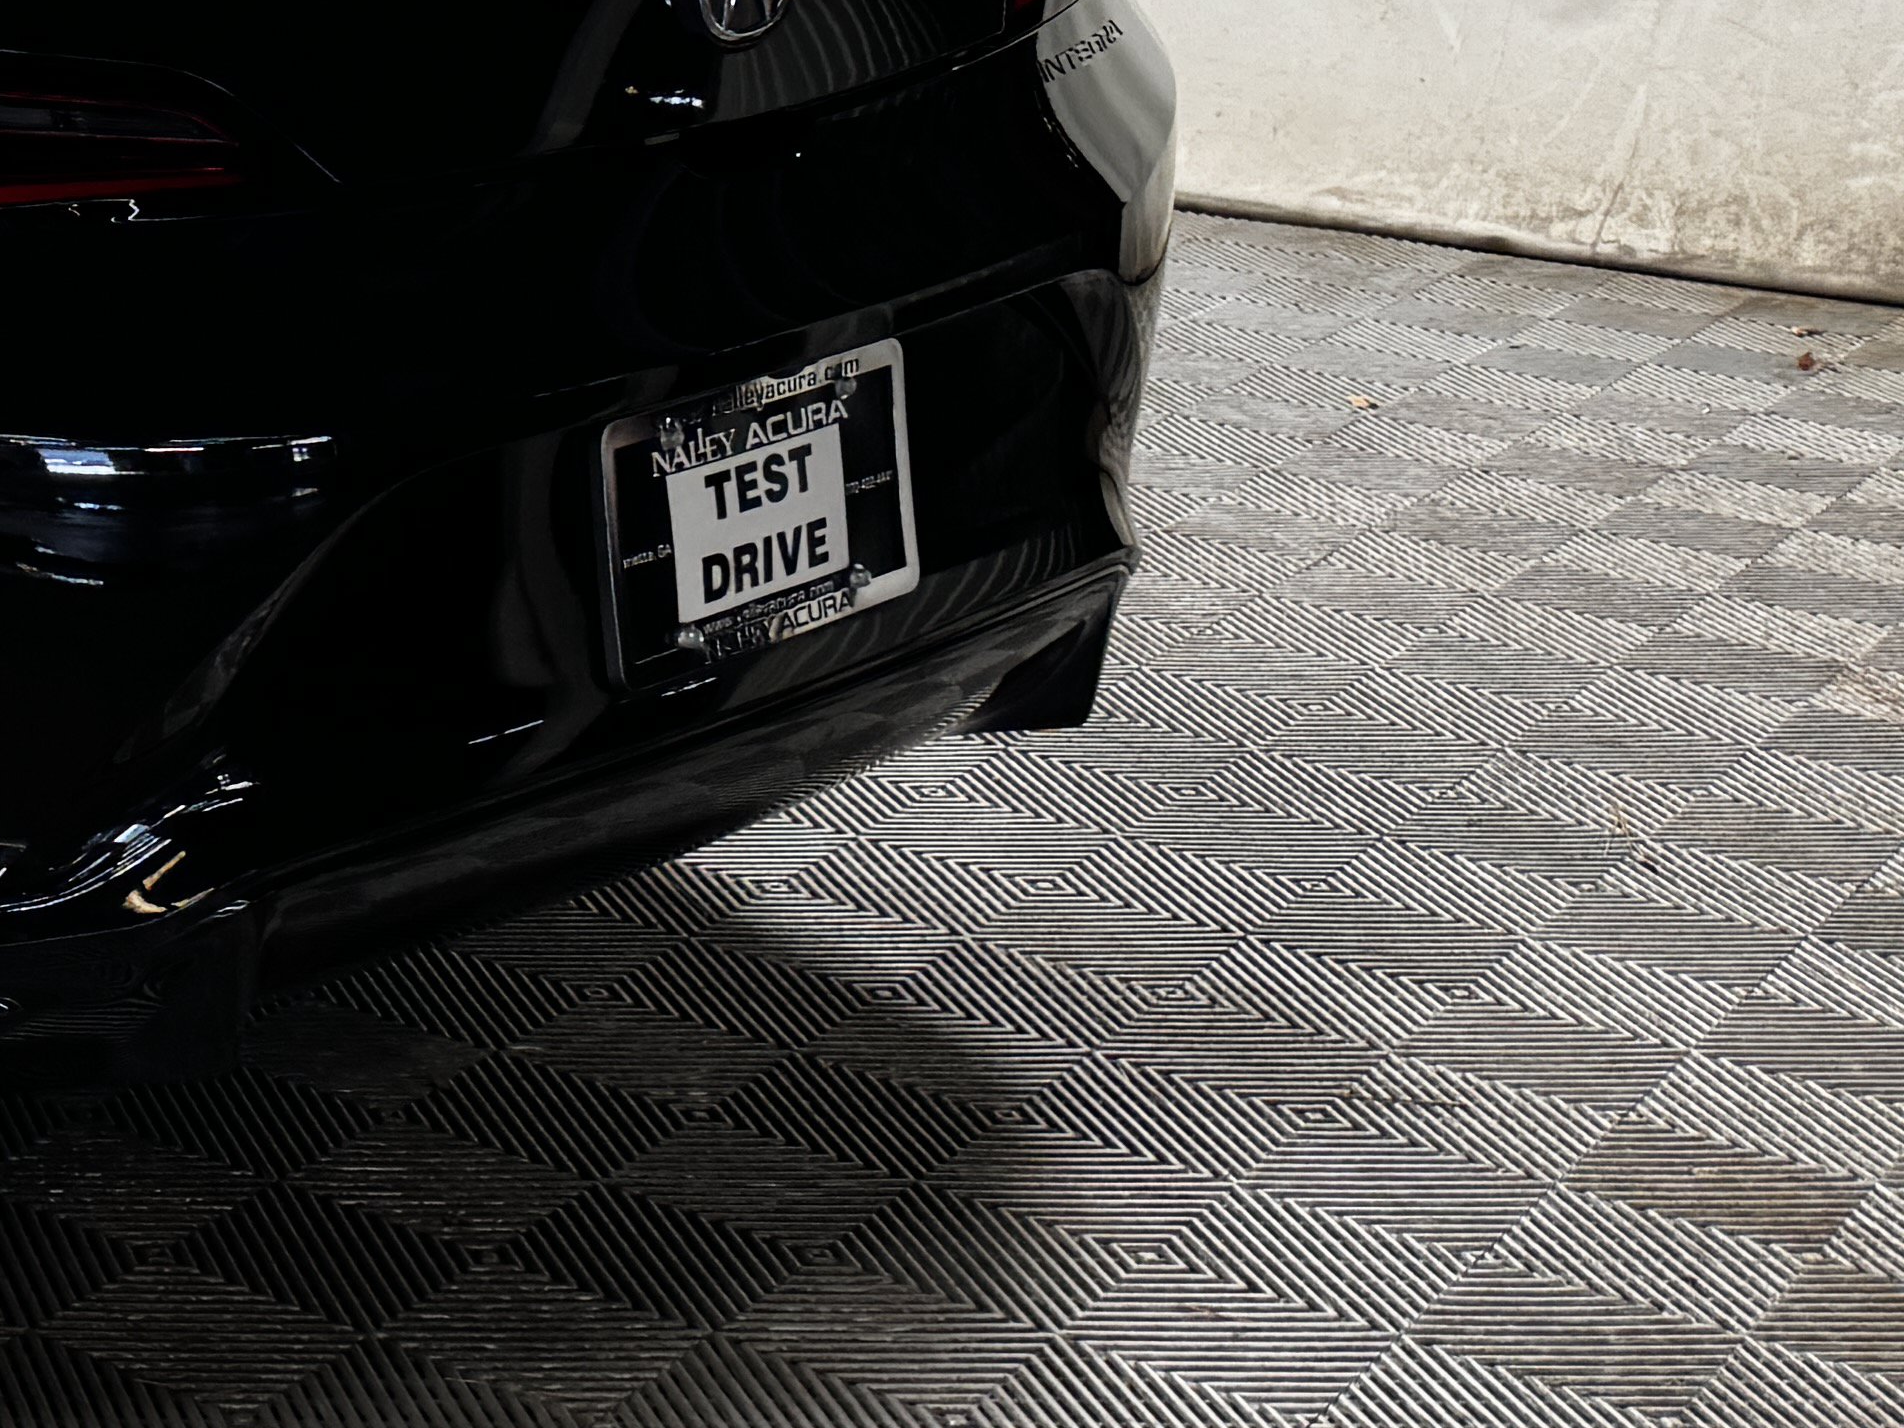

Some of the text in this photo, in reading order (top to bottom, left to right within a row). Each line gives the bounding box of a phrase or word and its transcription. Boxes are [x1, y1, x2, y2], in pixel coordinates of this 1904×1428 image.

[1037, 19, 1124, 84] INTEGRA
[651, 398, 849, 477] NALLEY ACURA
[703, 442, 814, 521] TEST
[701, 516, 831, 605] DRIVE
